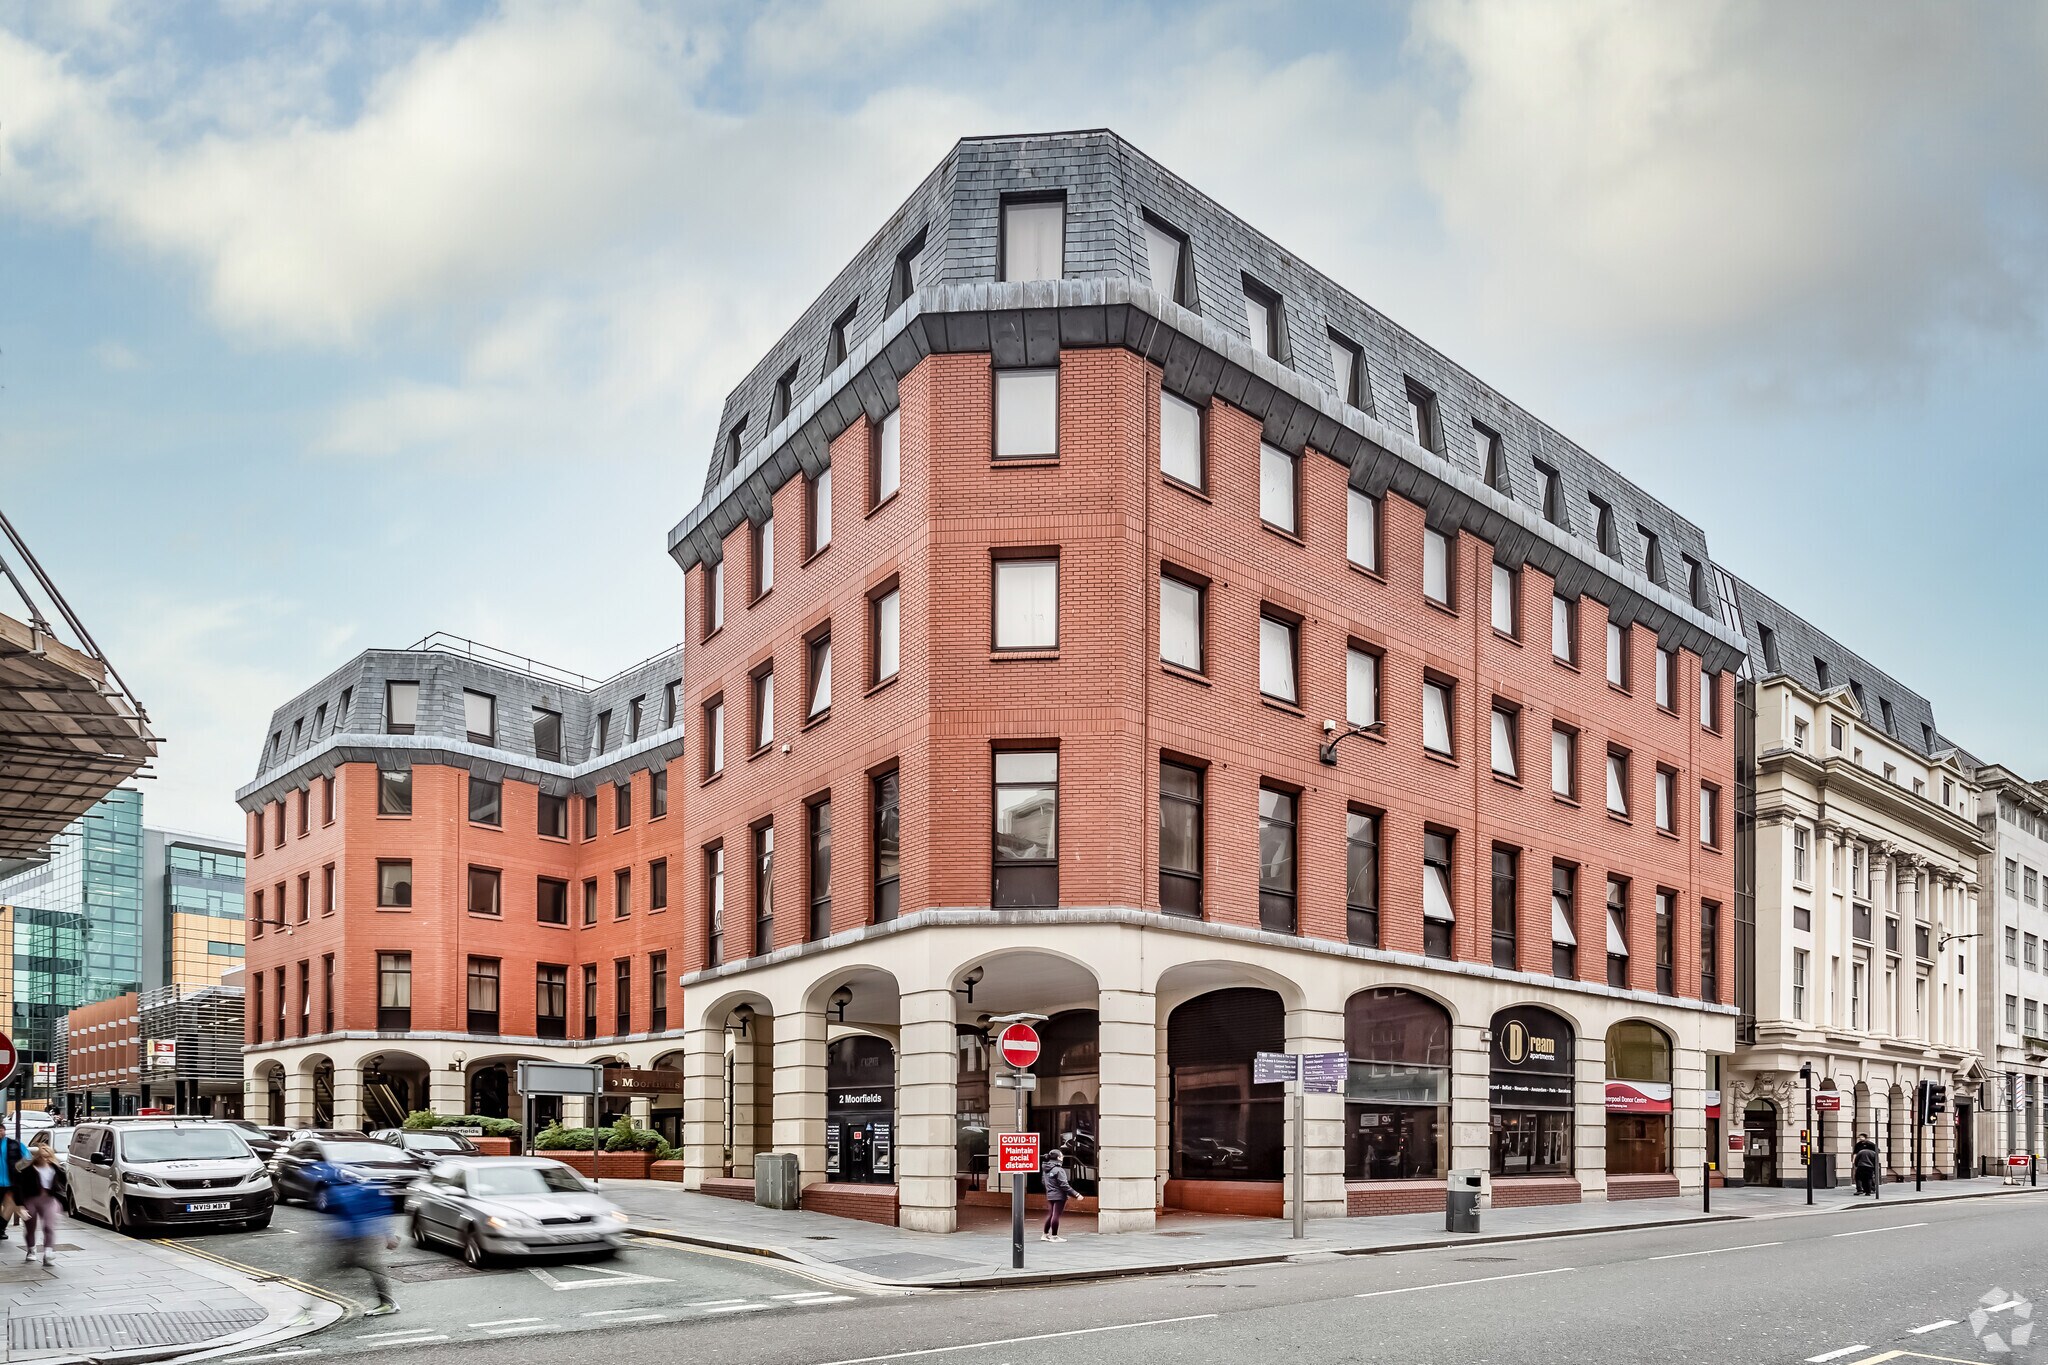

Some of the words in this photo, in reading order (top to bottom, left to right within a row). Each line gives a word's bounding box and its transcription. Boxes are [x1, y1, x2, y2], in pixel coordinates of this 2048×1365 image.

[1509, 1024, 1555, 1060] Dream
[1529, 1053, 1555, 1061] apartments
[839, 1095, 844, 1103] 2
[845, 1094, 882, 1103] Moorfields
[1005, 1161, 1034, 1169] distance
